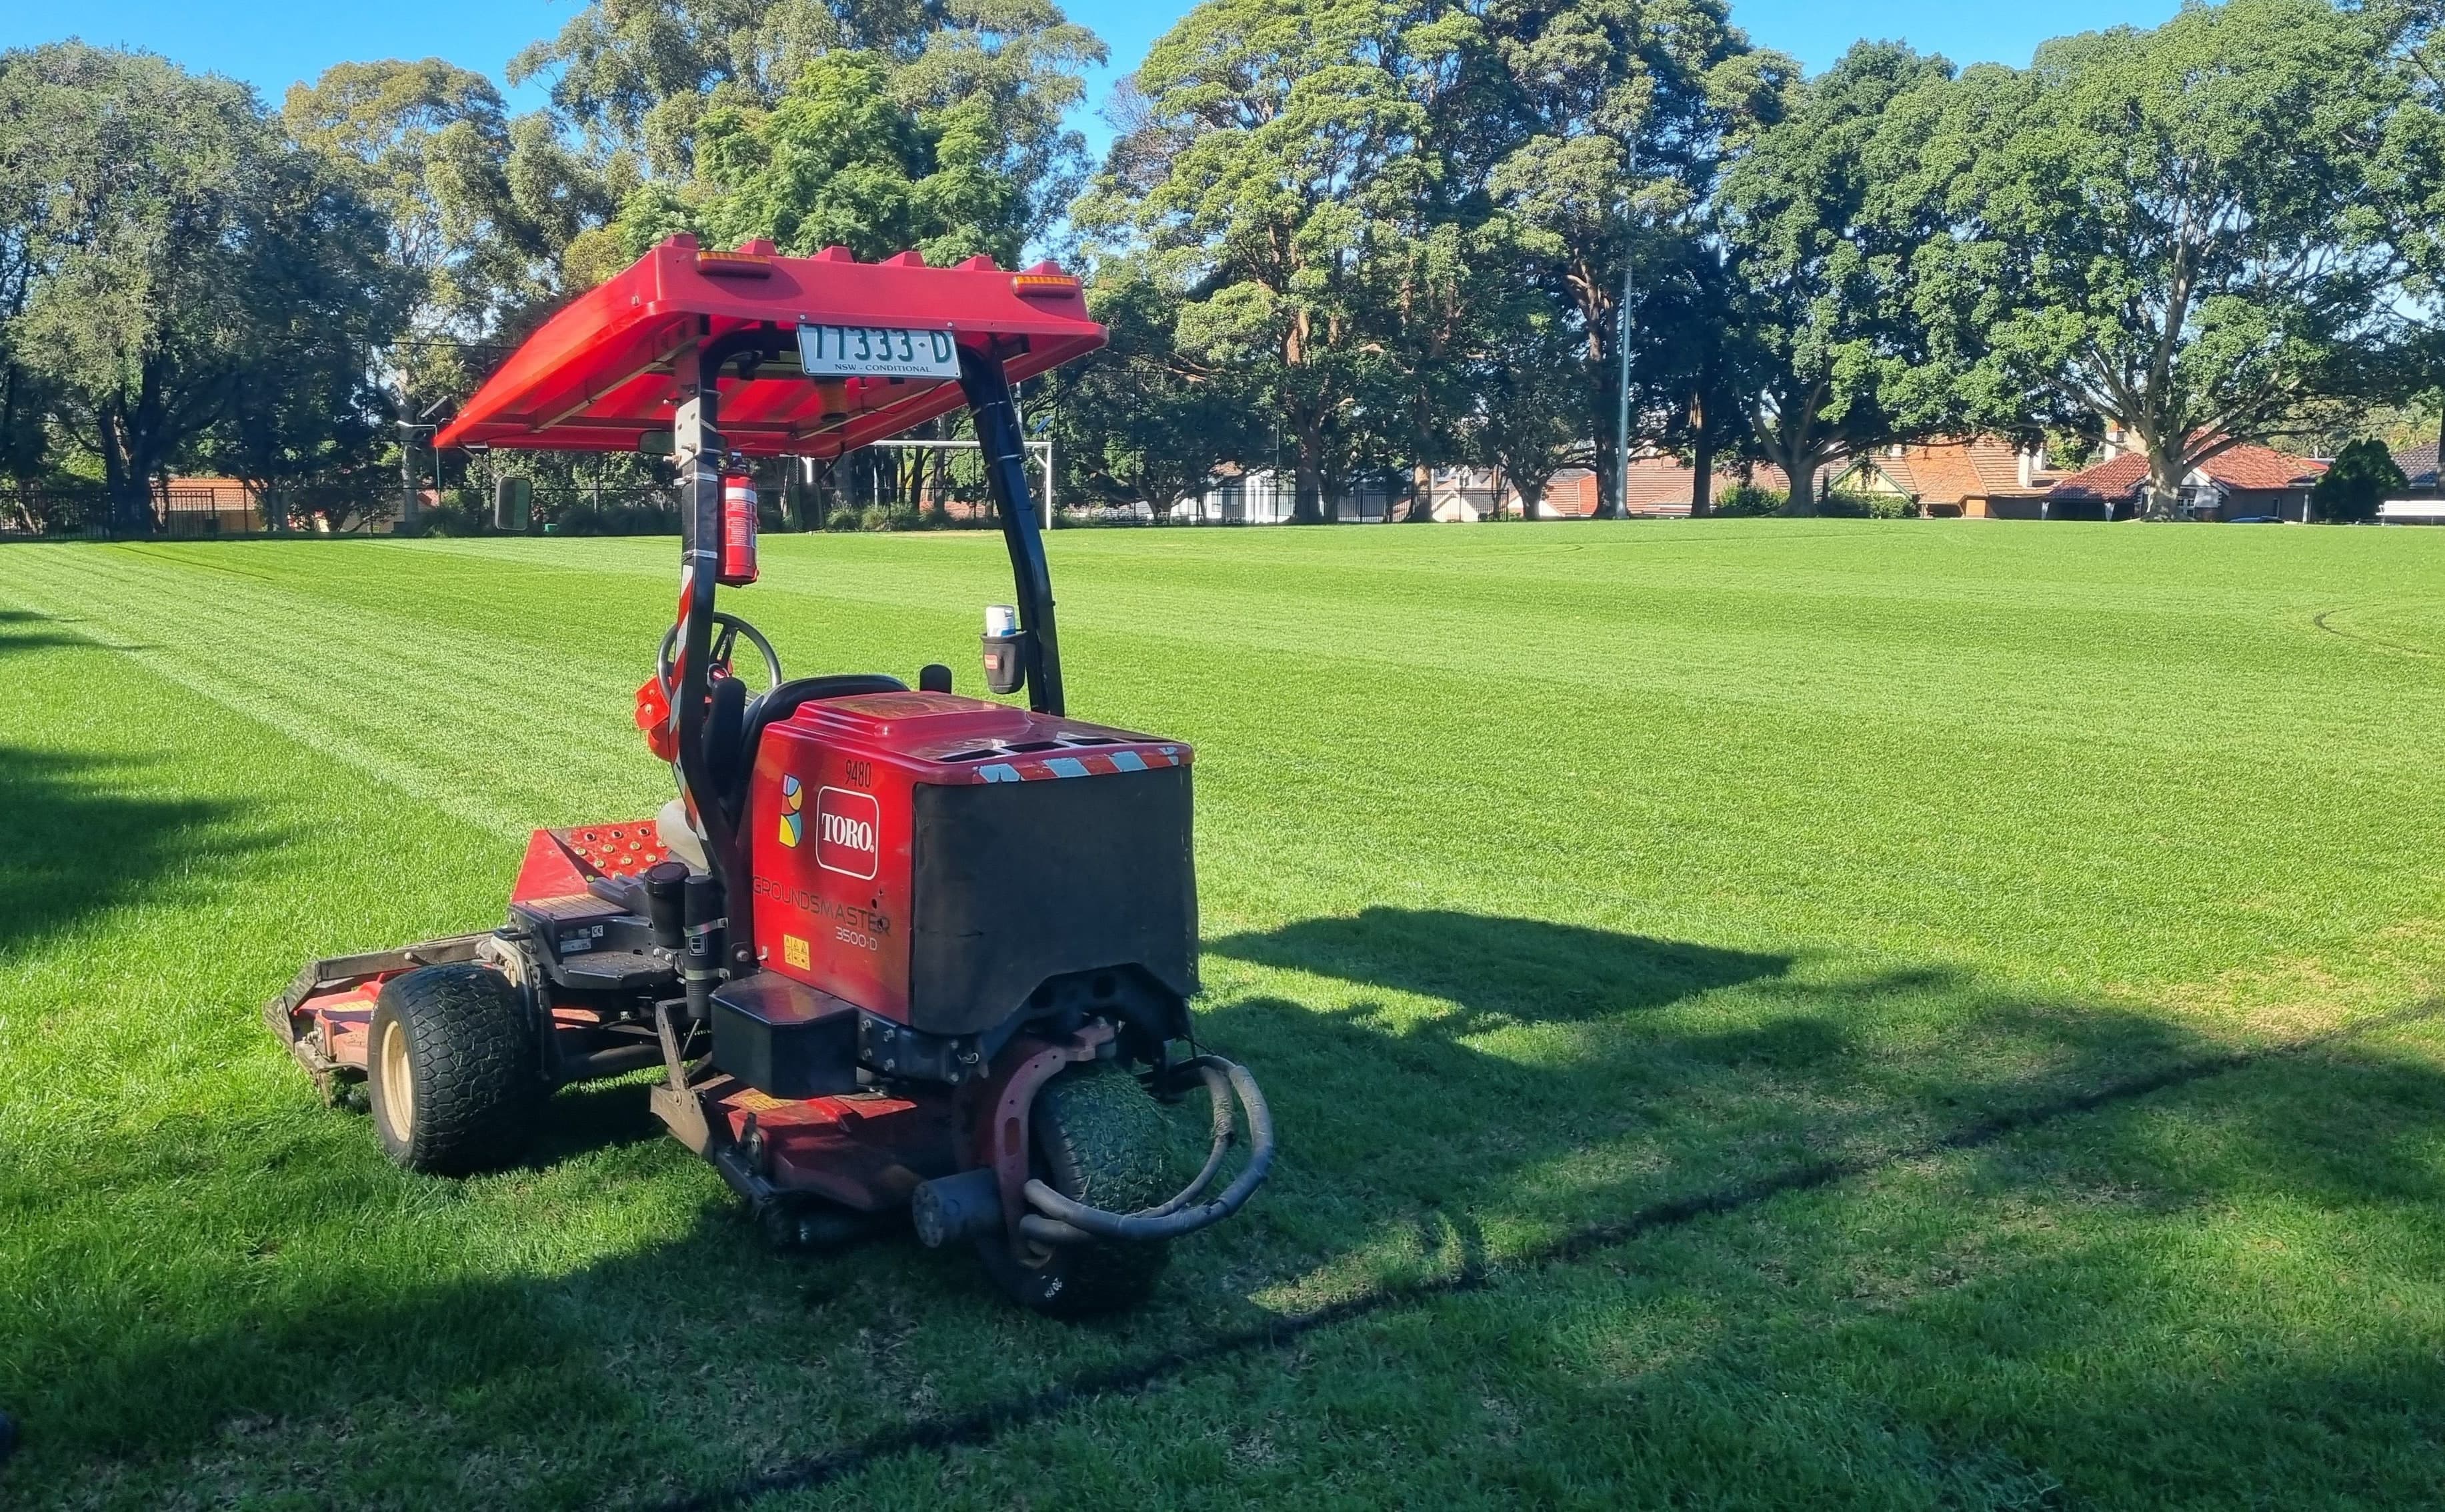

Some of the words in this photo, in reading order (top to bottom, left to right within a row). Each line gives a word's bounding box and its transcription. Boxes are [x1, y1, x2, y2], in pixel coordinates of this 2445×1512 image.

[865, 364, 931, 373] CONDITIONAL
[845, 759, 871, 788] 9480
[821, 813, 873, 851] TORO
[753, 875, 891, 936] GROUNDSMASTER
